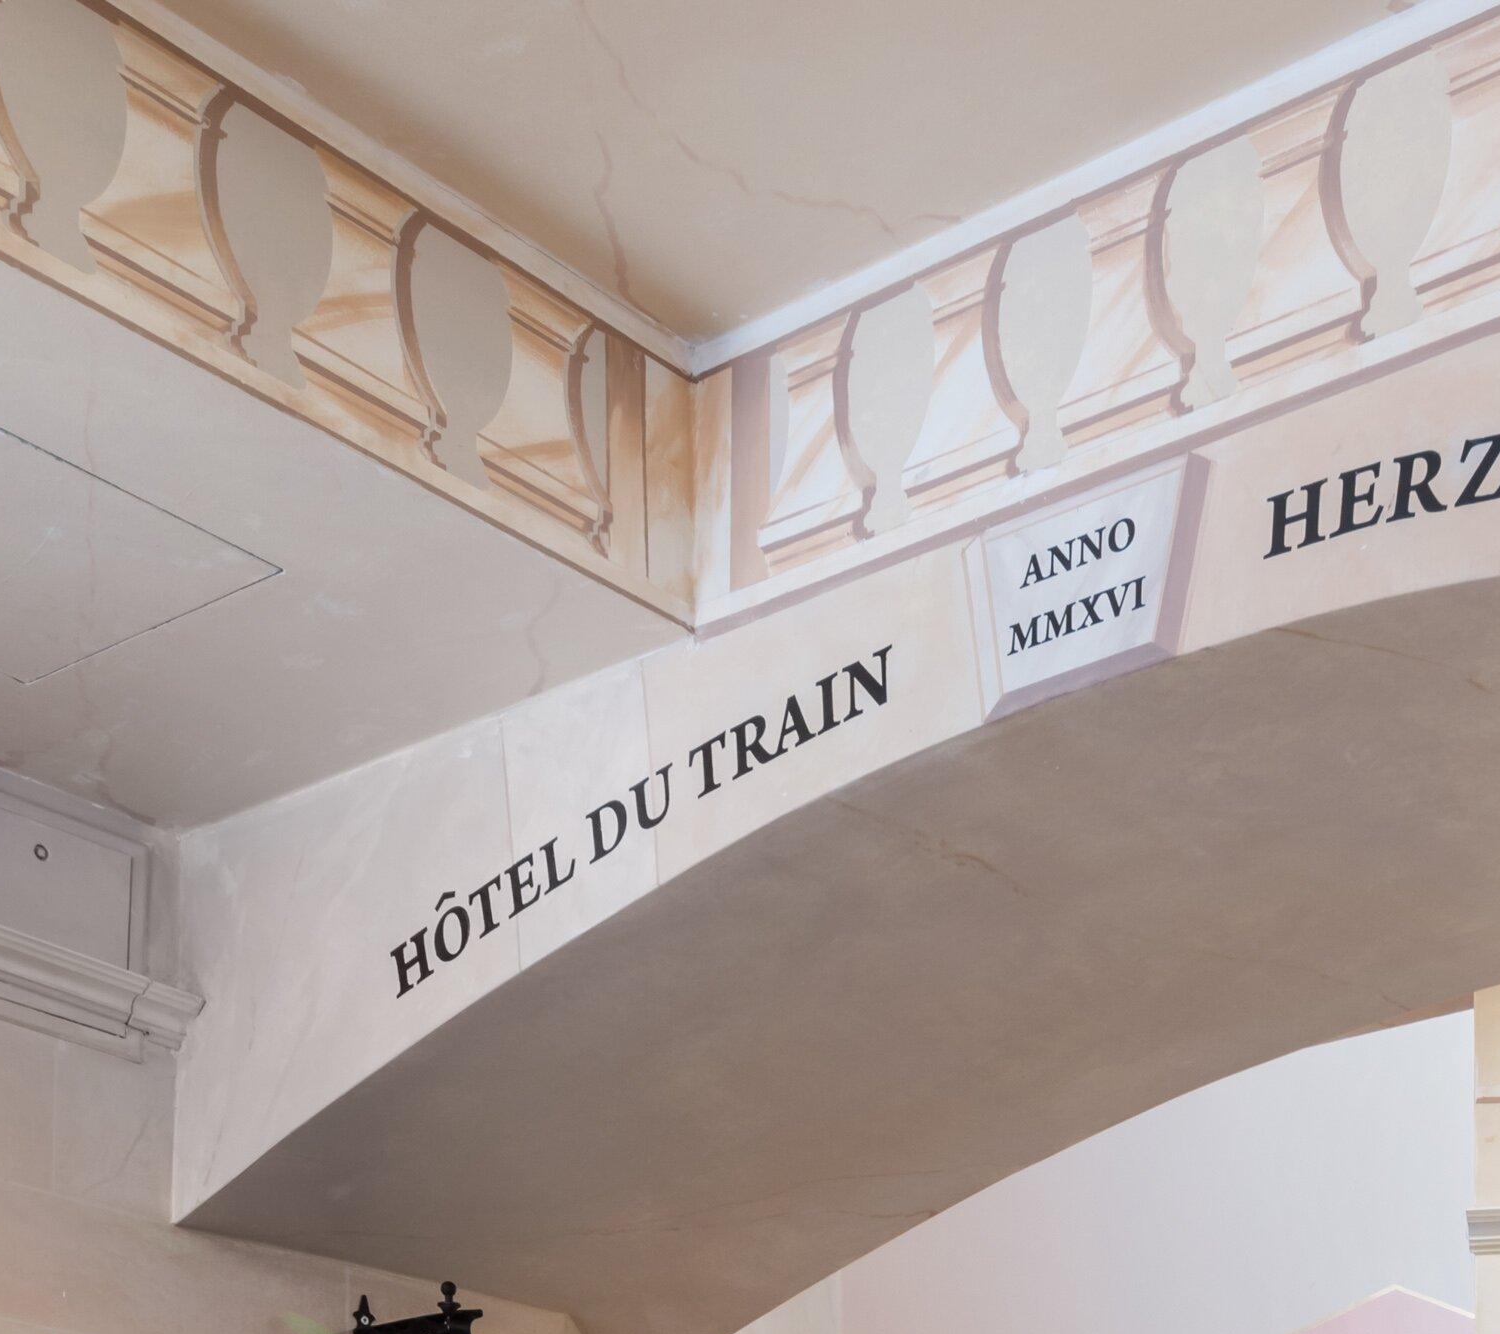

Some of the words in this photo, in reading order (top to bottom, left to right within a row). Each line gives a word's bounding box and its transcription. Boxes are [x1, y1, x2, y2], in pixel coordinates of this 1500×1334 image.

[1019, 517, 1136, 589] ANNO
[1007, 575, 1146, 656] MMXVI
[389, 836, 576, 999] HÔTEL
[585, 762, 673, 865] DU
[688, 644, 893, 800] TRAIN
